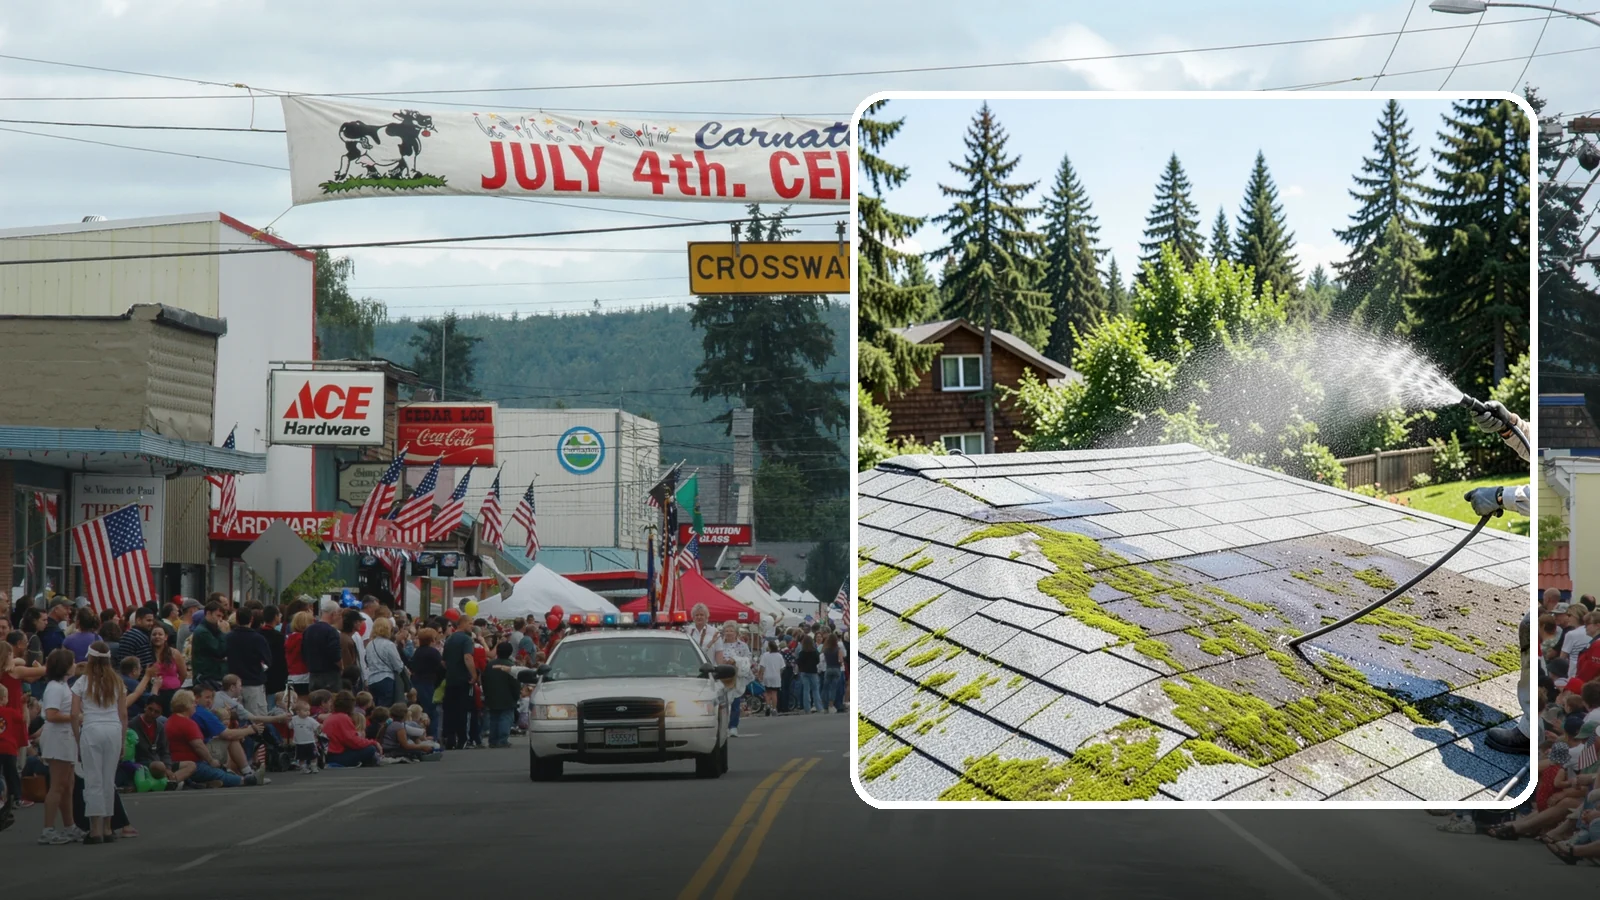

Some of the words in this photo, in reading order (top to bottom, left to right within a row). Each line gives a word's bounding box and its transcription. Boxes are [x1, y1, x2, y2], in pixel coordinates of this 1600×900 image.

[481, 141, 605, 192] JULY
[632, 150, 746, 198] 4th.
[697, 254, 850, 280] CROSSWA
[283, 380, 373, 420] ACE
[405, 409, 452, 421] CEDAR
[283, 421, 371, 436] Hardware
[416, 428, 476, 446] Coca-Cola
[95, 484, 124, 494] Vincent
[126, 486, 135, 494] de
[137, 486, 155, 494] Paul
[688, 527, 741, 535] CRNATION
[699, 535, 730, 543] GLASS
